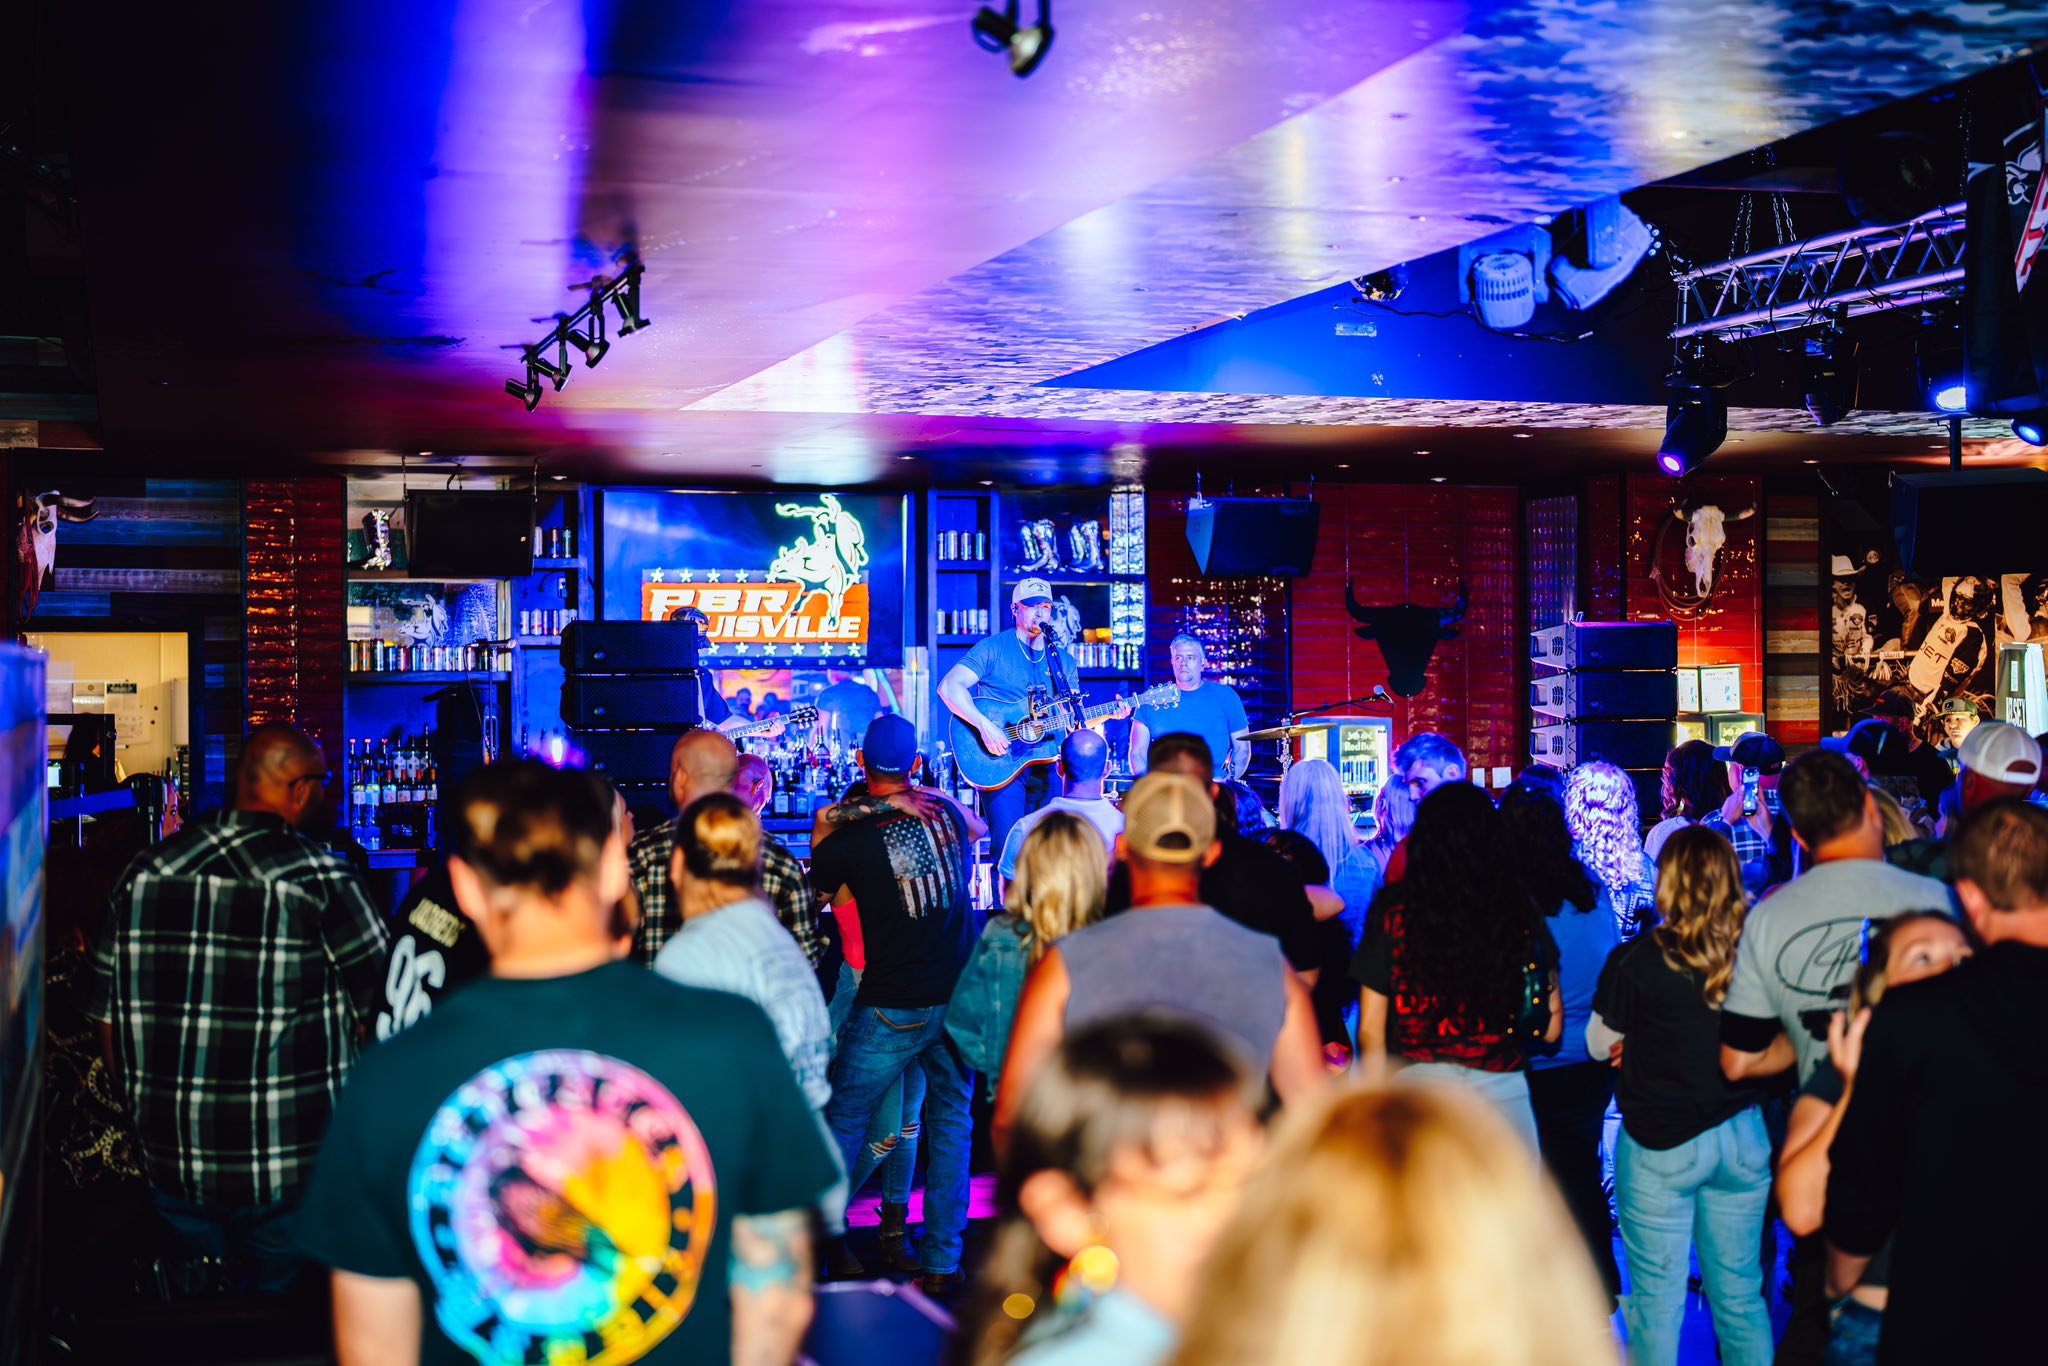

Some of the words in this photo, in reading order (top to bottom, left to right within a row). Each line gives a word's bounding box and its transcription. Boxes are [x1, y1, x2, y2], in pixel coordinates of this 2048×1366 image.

[649, 589, 789, 613] PBR
[651, 609, 862, 638] UISVILLE
[698, 658, 793, 667] OWBOY
[818, 658, 867, 667] BAR
[1344, 741, 1361, 751] Red
[1361, 741, 1376, 751] Bull
